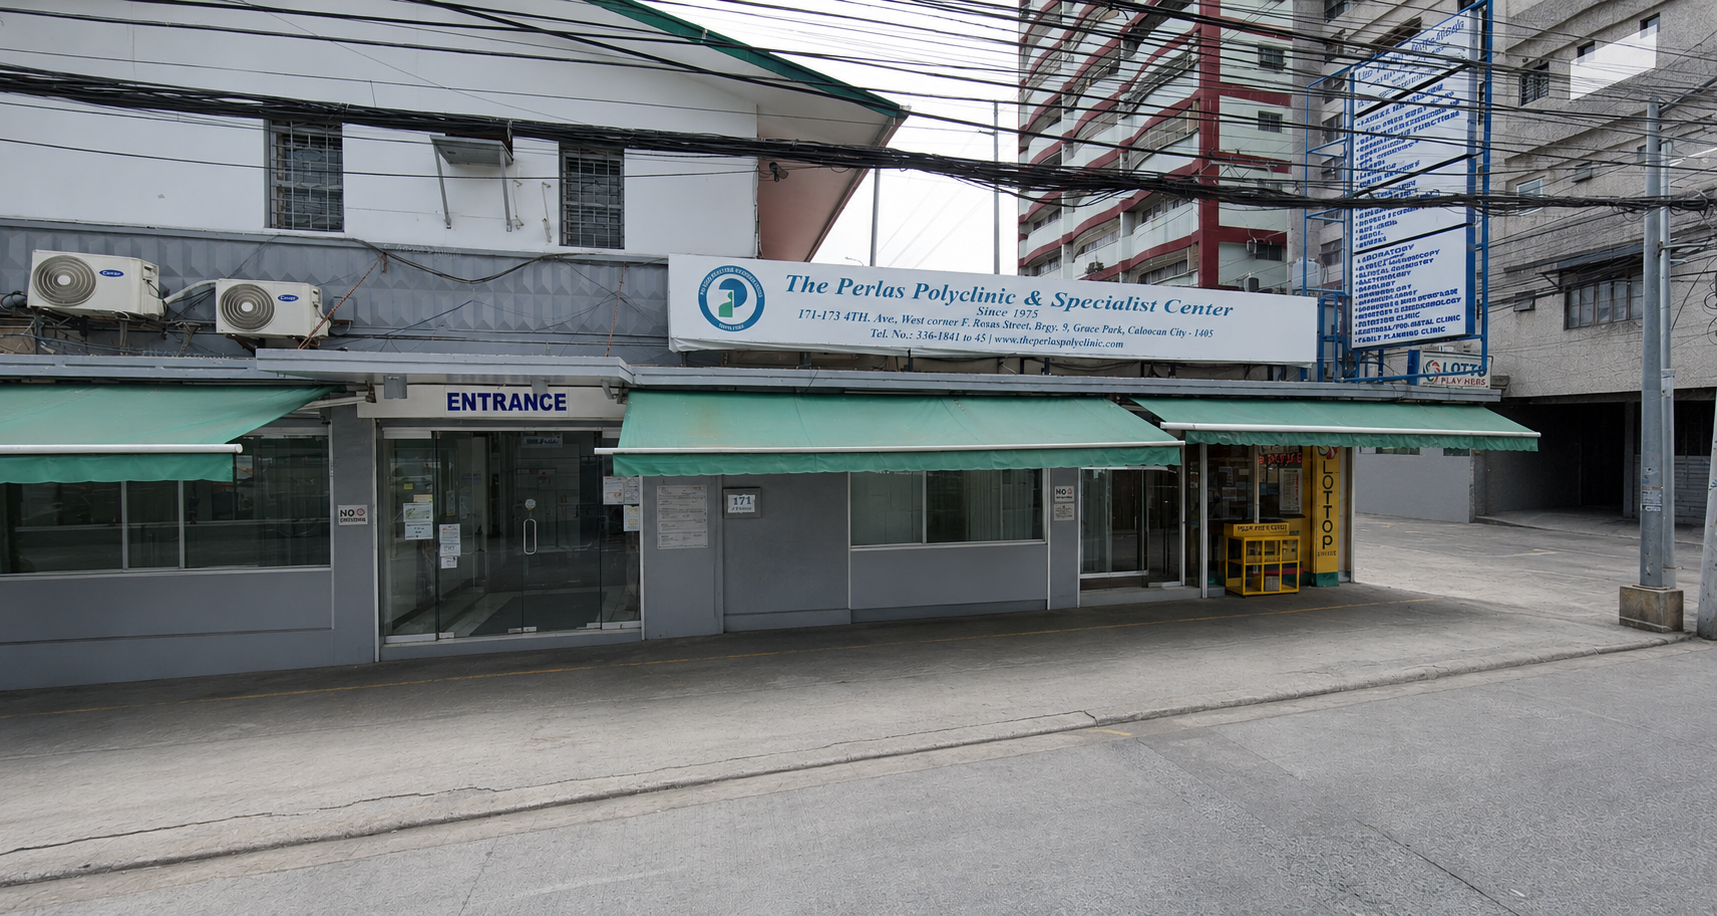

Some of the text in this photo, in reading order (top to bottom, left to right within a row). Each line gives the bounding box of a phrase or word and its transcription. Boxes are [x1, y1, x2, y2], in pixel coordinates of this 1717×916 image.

[786, 274, 829, 294] The
[835, 278, 906, 299] Perlas
[912, 283, 1016, 306] Polyclinic
[1024, 290, 1042, 306] &
[1050, 292, 1157, 312] Specialist
[1164, 298, 1234, 316] Center
[976, 306, 1038, 318] Since 1975
[798, 309, 841, 321] 171-173
[844, 311, 870, 322] 4TH.
[902, 314, 925, 325] West
[927, 318, 958, 327] corner
[961, 318, 970, 327] F.
[1035, 322, 1058, 333] Brgy.
[1062, 323, 1070, 332] 9,
[1073, 323, 1100, 333] Grace
[1102, 325, 1125, 337] Park,
[1128, 325, 1167, 336] Caloocan
[1170, 328, 1187, 338] City
[1194, 328, 1214, 338] 1405
[871, 328, 888, 338] Tel.
[916, 330, 960, 341] 336-1841
[974, 333, 986, 342] 45
[447, 392, 567, 411] ENTRANCE
[733, 496, 751, 505] 171
